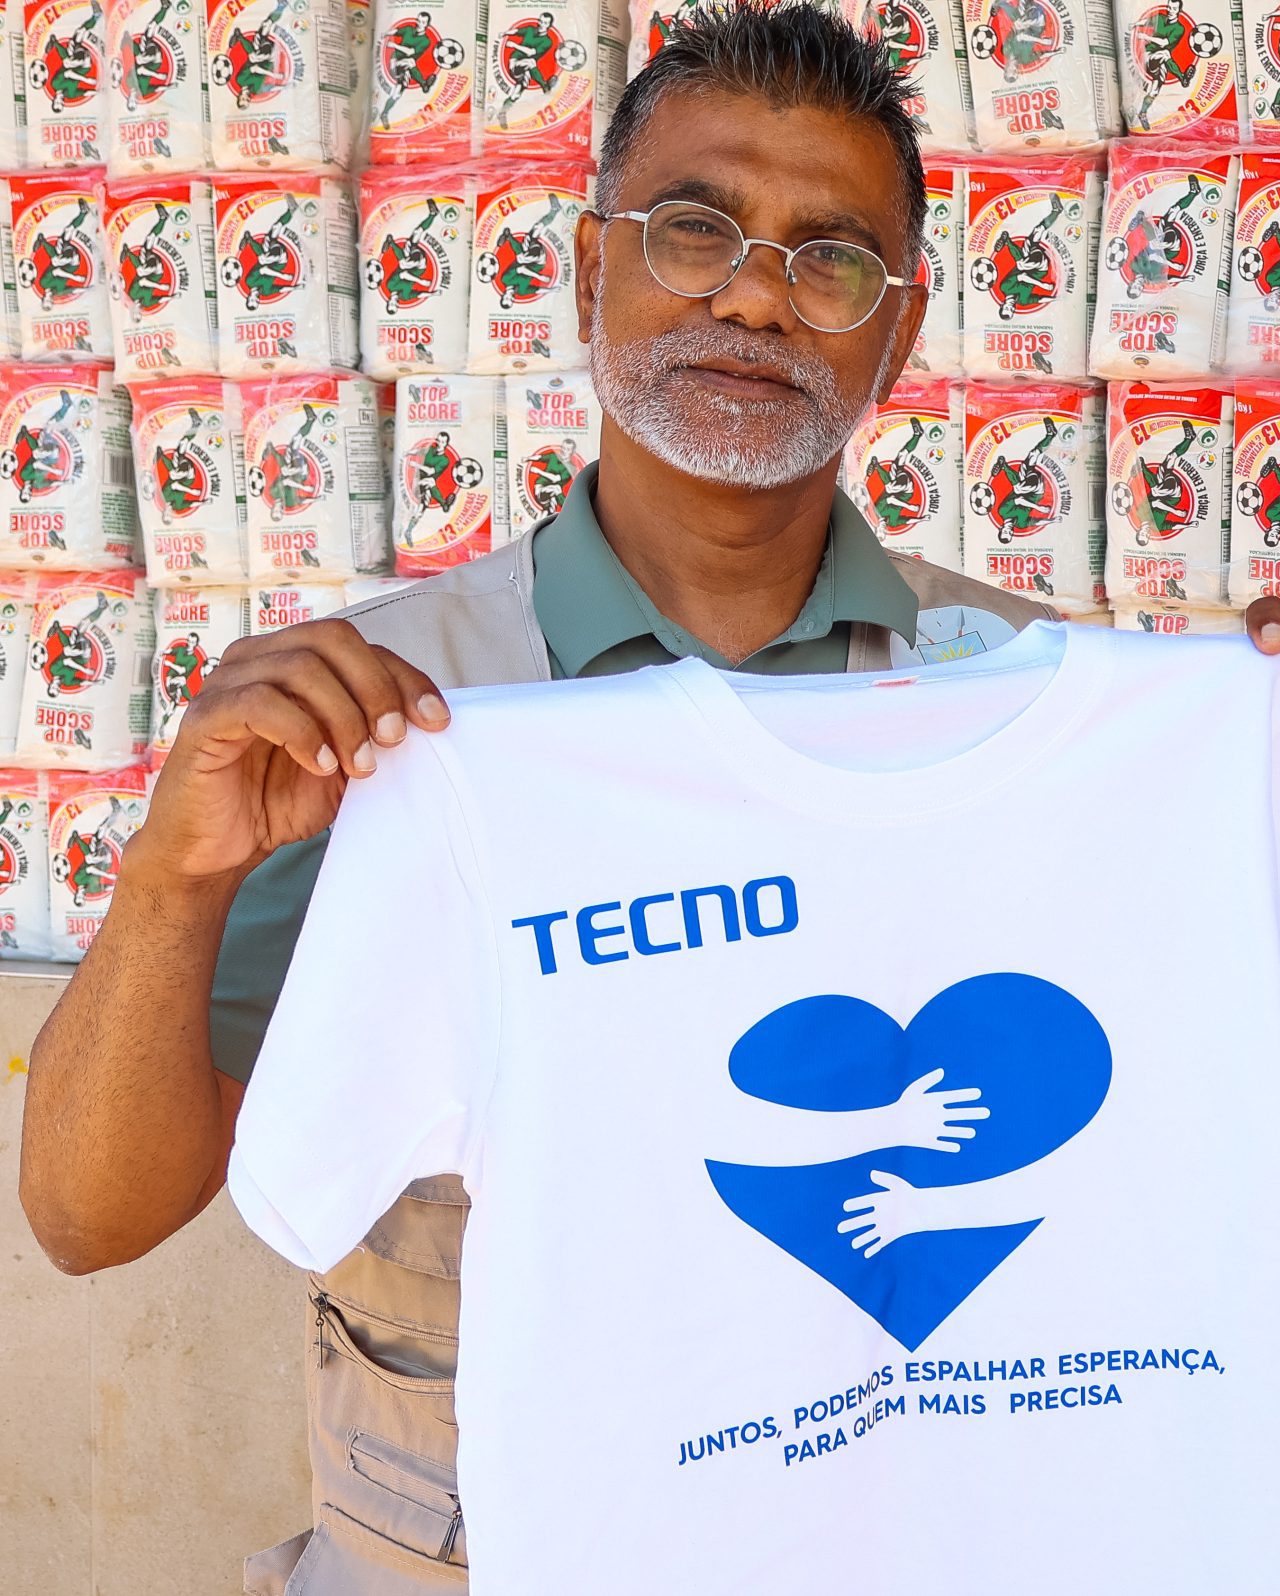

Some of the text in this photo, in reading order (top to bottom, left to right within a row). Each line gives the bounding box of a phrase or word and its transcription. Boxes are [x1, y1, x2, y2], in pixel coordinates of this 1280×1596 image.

[995, 90, 1060, 117] SCORE
[42, 124, 97, 142] SCORE
[226, 121, 286, 141] SCORE
[1010, 114, 1048, 133] TOP
[53, 142, 82, 160] TOP
[240, 140, 271, 157] TOP
[995, 198, 1015, 220] 13
[1180, 212, 1207, 276] FORÇA ENERGIA
[33, 320, 90, 340] SCORE
[236, 322, 294, 341] SCORE
[378, 326, 433, 345] SCORE
[490, 321, 549, 340] SCORE
[126, 330, 175, 355] SCORE
[250, 340, 280, 357] TOP
[501, 338, 533, 354] TOP
[986, 331, 1053, 351] SCORE
[1120, 333, 1156, 351] TOP
[137, 350, 165, 370] TOP
[1000, 352, 1035, 371] TOP
[419, 385, 448, 401] TOP
[542, 393, 575, 408] TOP
[408, 404, 460, 421] SCORE
[528, 408, 587, 428] SCORE
[991, 422, 1012, 445] 13
[1130, 425, 1151, 446] 13
[909, 454, 941, 514] FORÇA ENERGIA
[1178, 457, 1209, 521] FORÇA ENERGIA
[11, 514, 64, 532] SCORE
[20, 530, 51, 548] TOP
[154, 533, 206, 553] SCORE
[263, 532, 318, 551] SCORE
[166, 551, 193, 569] TOP
[272, 550, 302, 568] TOP
[988, 555, 1053, 576] SCORE
[1125, 558, 1185, 580] SCORE
[1003, 575, 1037, 592] TOP
[1136, 579, 1169, 598] TOP
[272, 592, 299, 607] TOP
[165, 604, 209, 621] SCORE
[258, 608, 311, 626] SCORE
[1153, 614, 1189, 634] TOP
[36, 708, 92, 730] SCORE
[44, 729, 75, 745] TOP
[511, 875, 799, 975] TECNO
[678, 1348, 1227, 1465] JUNTOS, PODEMOS ESPALHAR ESPERANÇA,
[783, 1384, 1123, 1467] PARA QUEM MAIS PRECISA
